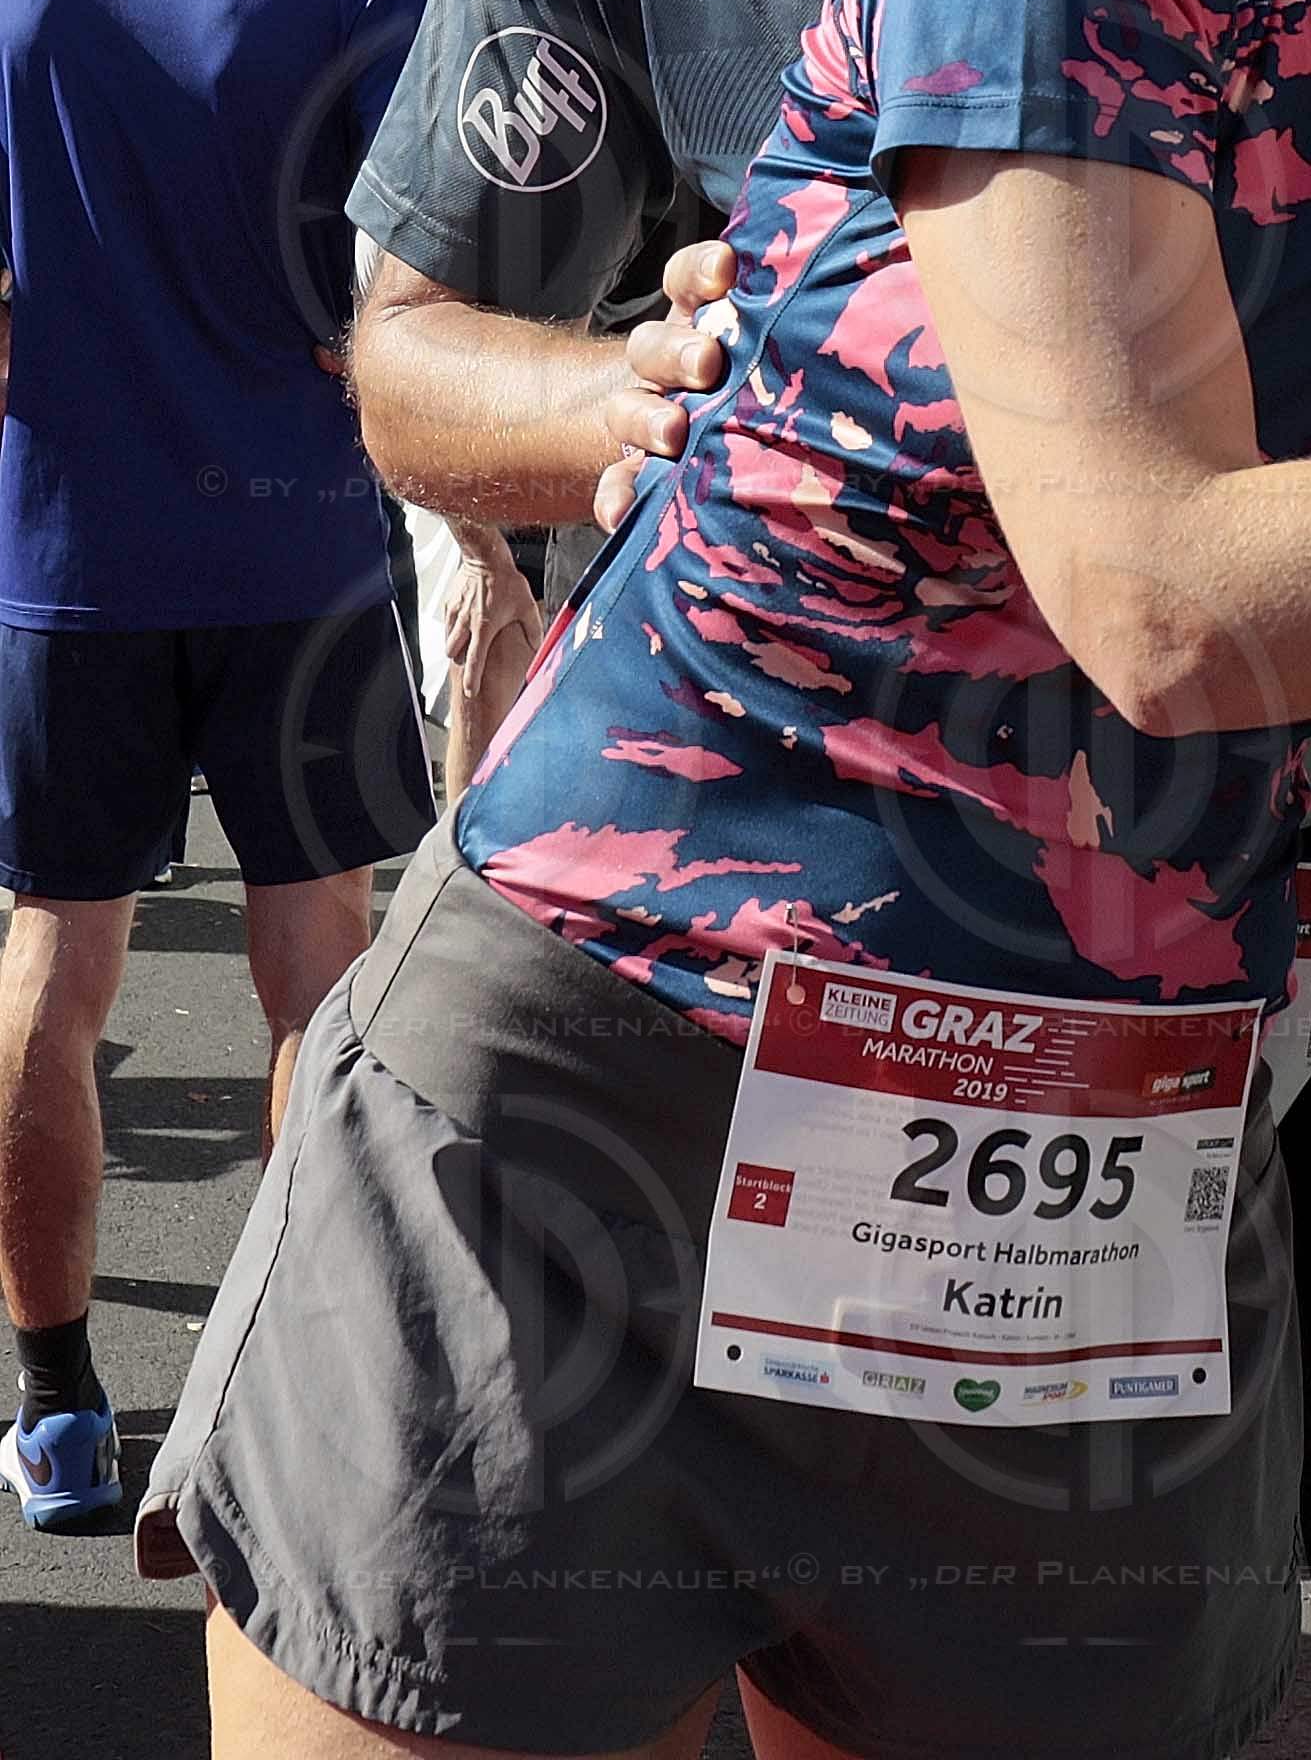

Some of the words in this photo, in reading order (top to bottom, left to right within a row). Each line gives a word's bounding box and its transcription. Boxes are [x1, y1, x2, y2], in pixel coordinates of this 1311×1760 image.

[827, 989, 892, 1011] KLEINE
[824, 1004, 890, 1028] ZEITUNG
[901, 999, 1044, 1054] GRAZ
[862, 1038, 994, 1076] MARATHON
[953, 1078, 1009, 1103] 2019
[735, 1173, 794, 1194] Startblock
[890, 1117, 1144, 1220] 2695
[753, 1192, 767, 1211] 2
[851, 1221, 987, 1263] Gigasport
[993, 1240, 1140, 1267] Halbmarathon
[942, 1278, 1065, 1320] Katrin
[763, 1366, 819, 1384] SPARKASSE
[1112, 1379, 1174, 1396] PUNTIGAMER
